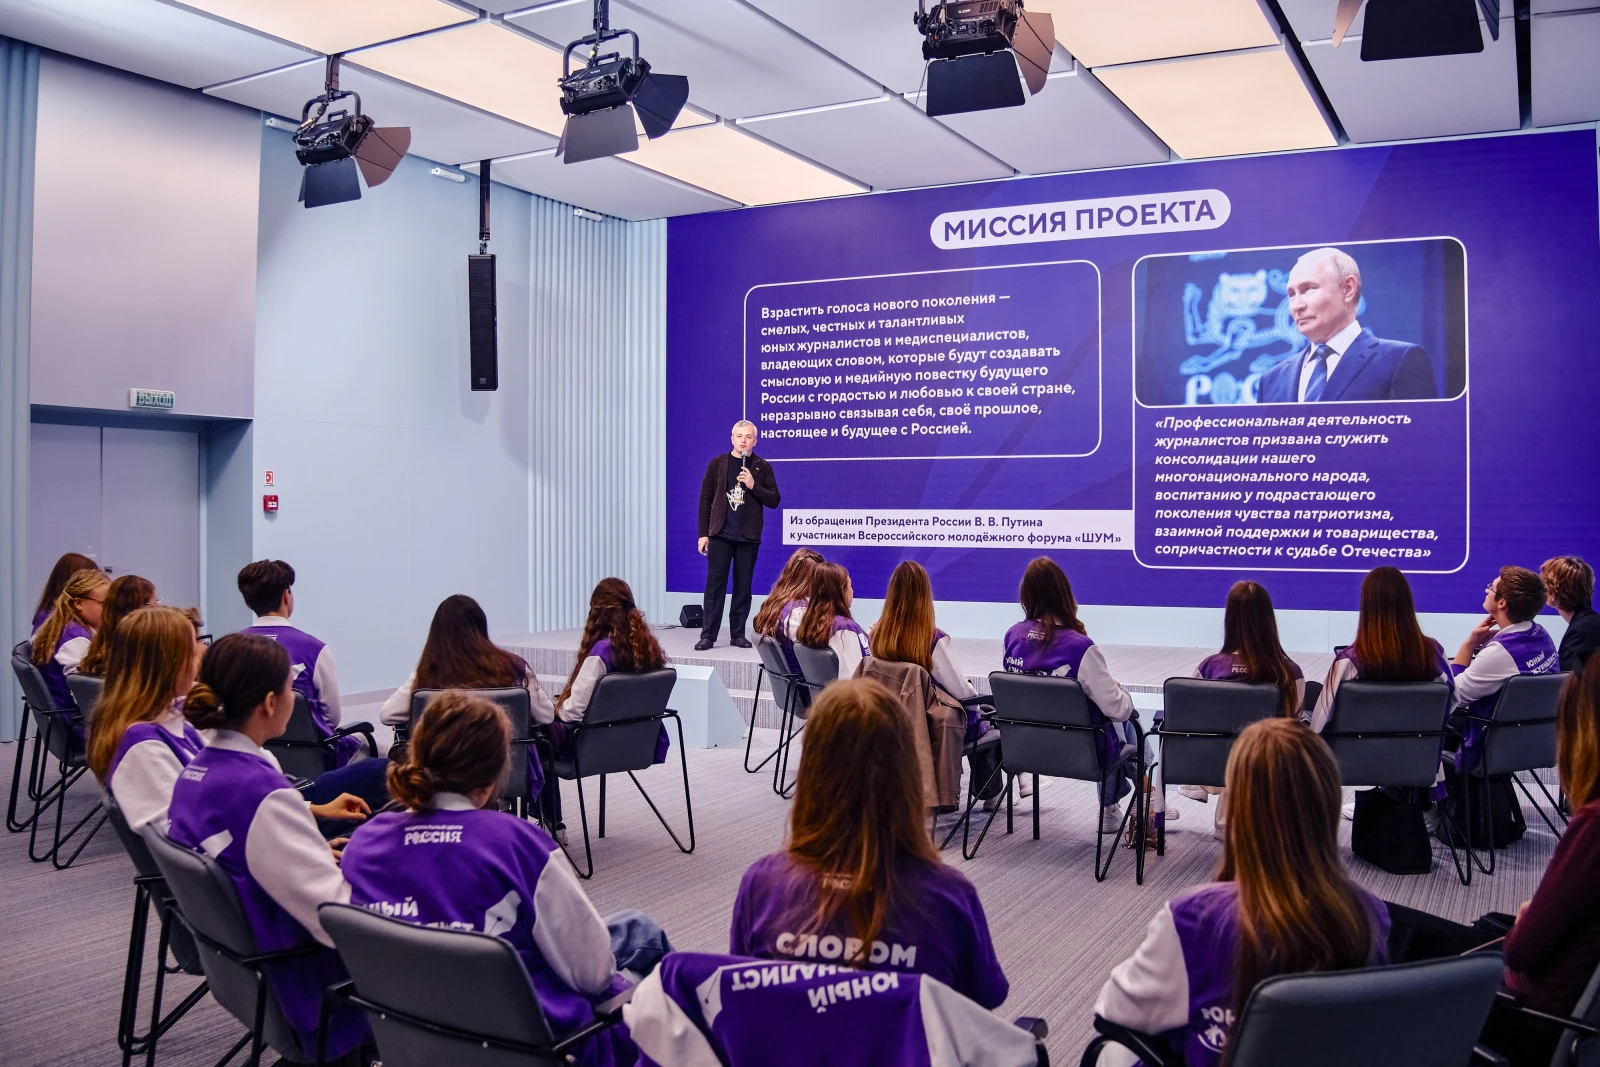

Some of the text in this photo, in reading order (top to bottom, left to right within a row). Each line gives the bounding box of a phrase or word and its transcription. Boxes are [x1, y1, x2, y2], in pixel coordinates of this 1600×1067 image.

[944, 199, 1216, 241] МИССИЯ ПРОЕКТА
[762, 306, 824, 321] Взрастить
[827, 303, 870, 314] голоса
[873, 300, 919, 311] нового
[922, 294, 996, 308] поколения
[761, 314, 965, 336] смелых, честных и талантливых
[761, 330, 1029, 353] юных журналистов и медиспециалистов,
[761, 347, 1060, 371] владеющих словом, которые будут создавать
[761, 365, 1048, 388] смысловую и медийную повестку будущего
[138, 393, 173, 408] ВЫХОД
[761, 383, 1075, 404] России с гордостью и любовью к своей стране,
[761, 403, 1042, 424] неразрывно связывая себя, своё прошлое,
[761, 421, 972, 439] настоящее и будущее с Россией.
[1155, 415, 1411, 431] «Профессиональная деятельность
[1154, 434, 1389, 450] журналистов призвана служить
[1155, 454, 1316, 466] консолидации нашего
[1155, 472, 1370, 485] многонационального народа,
[1155, 491, 1376, 504] воспитанию у подрастающего
[790, 515, 1043, 529] Из обращения Президента России В. В. Путина
[1155, 510, 1394, 522] поколения чувства патриотизма,
[797, 532, 855, 541] участникам
[858, 530, 945, 543] Всероссийского
[948, 532, 1025, 543] молодёжного
[1027, 532, 1071, 545] форума
[1075, 533, 1121, 543] «ШУМ»
[1155, 525, 1438, 542] взаимной поддержки и товарищества,
[1155, 544, 1431, 559] сопричастности к судьбе Отечества»
[776, 932, 917, 968] СЛОВОМ
[731, 963, 856, 992] НАЛИСТ
[807, 972, 900, 1014] ЮНЫЙ
